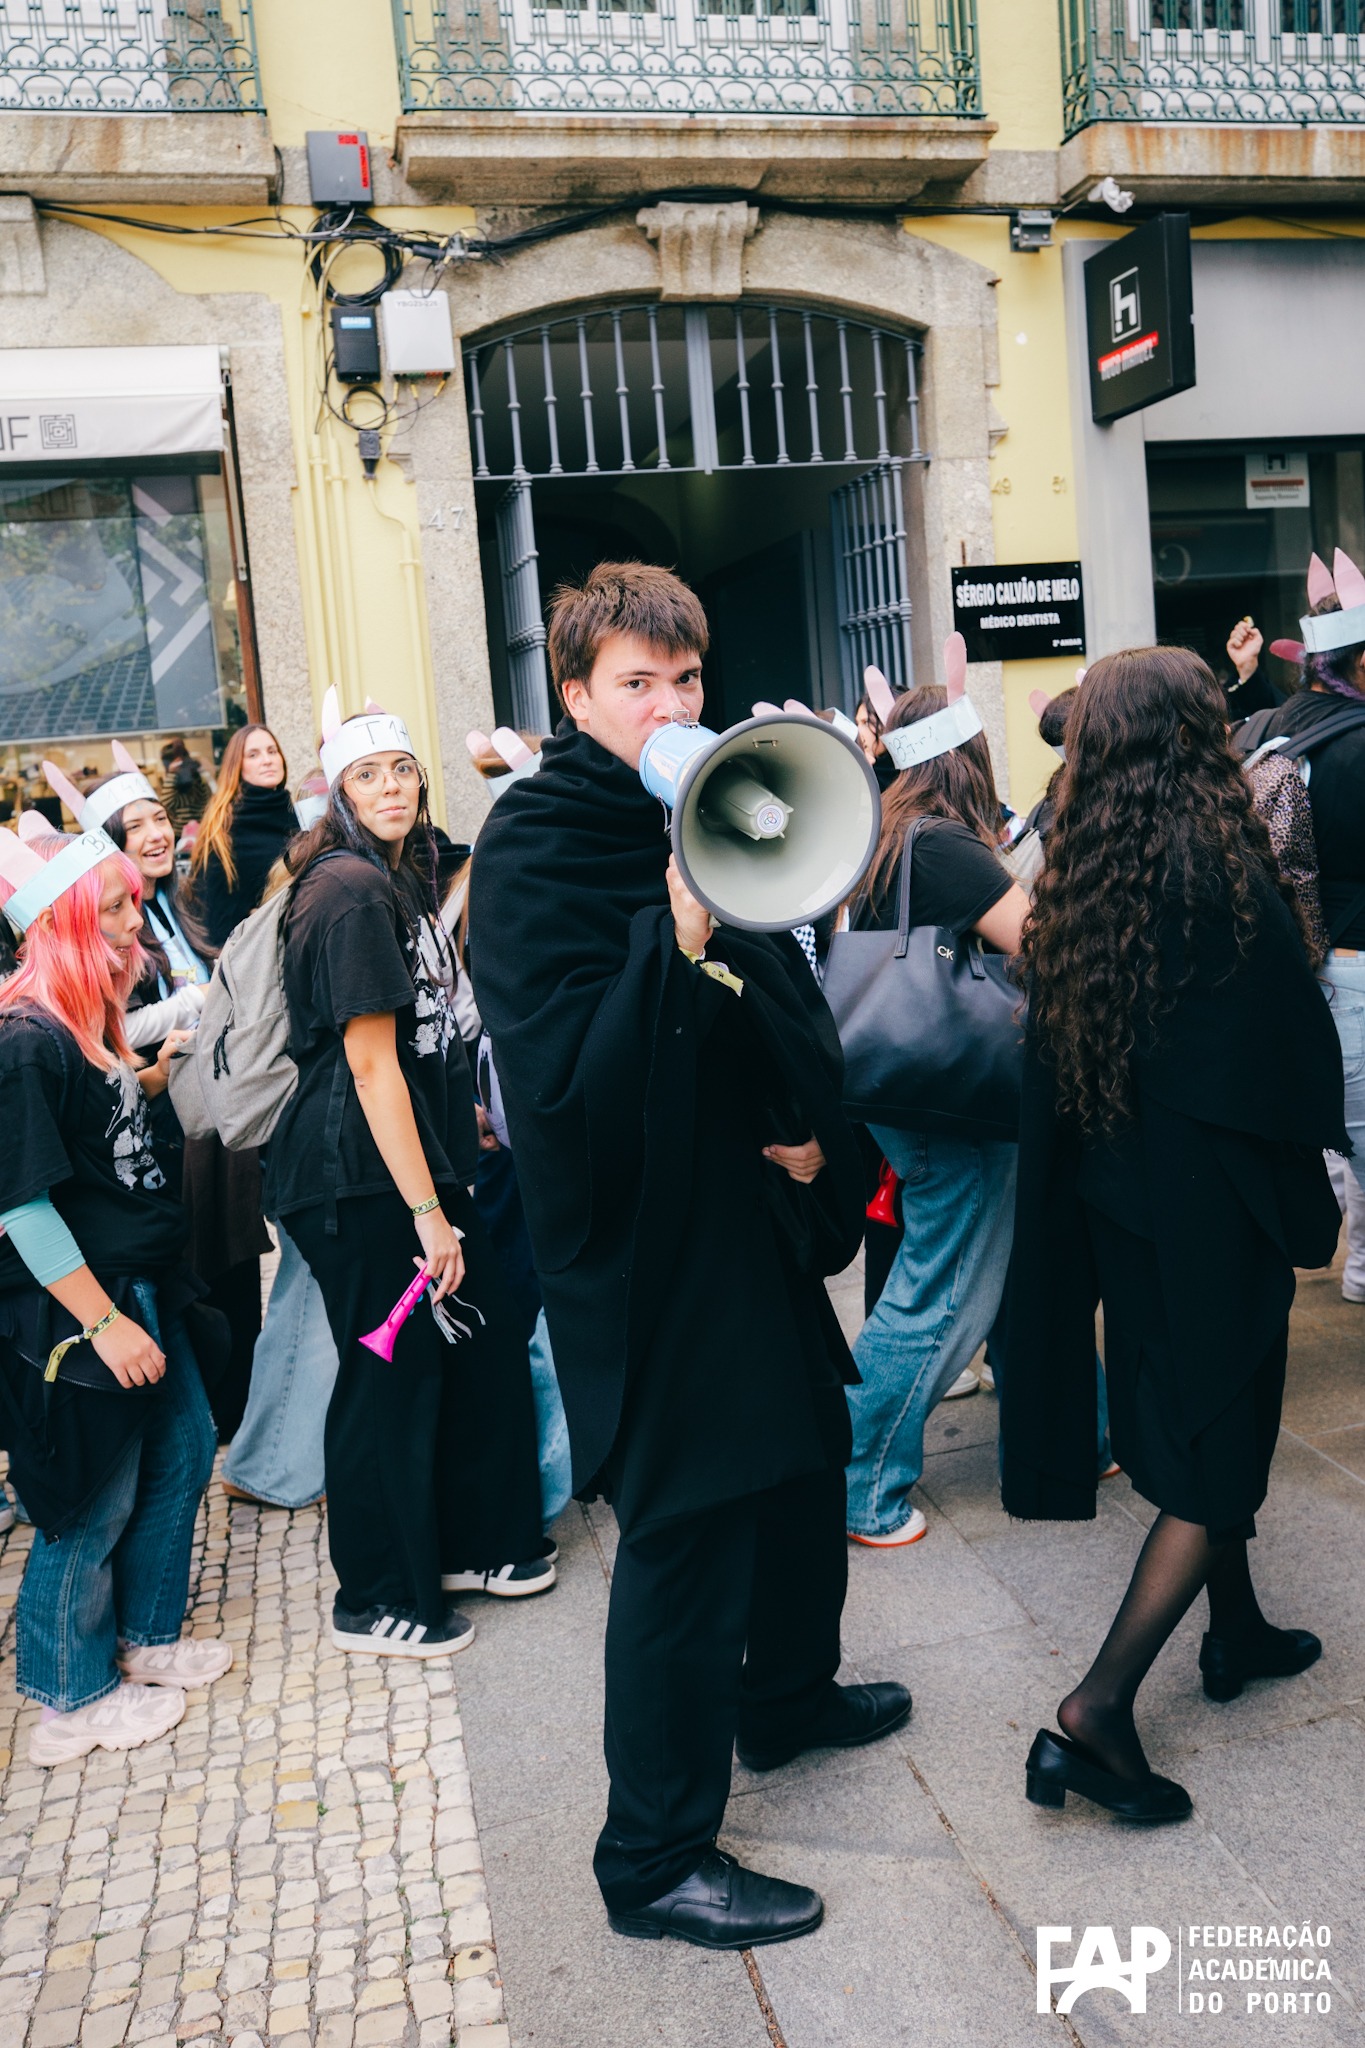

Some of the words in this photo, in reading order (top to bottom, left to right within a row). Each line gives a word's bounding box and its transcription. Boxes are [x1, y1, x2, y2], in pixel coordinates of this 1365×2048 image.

[0, 416, 30, 451] F
[428, 506, 464, 530] 47
[956, 580, 995, 608] SÉRGIO
[995, 576, 1036, 605] CALVÃO
[1036, 579, 1051, 602] DE
[1051, 578, 1080, 601] MELO
[980, 614, 1016, 629] MÉDICO
[1016, 612, 1060, 627] DENTISTA
[937, 945, 954, 960] CK
